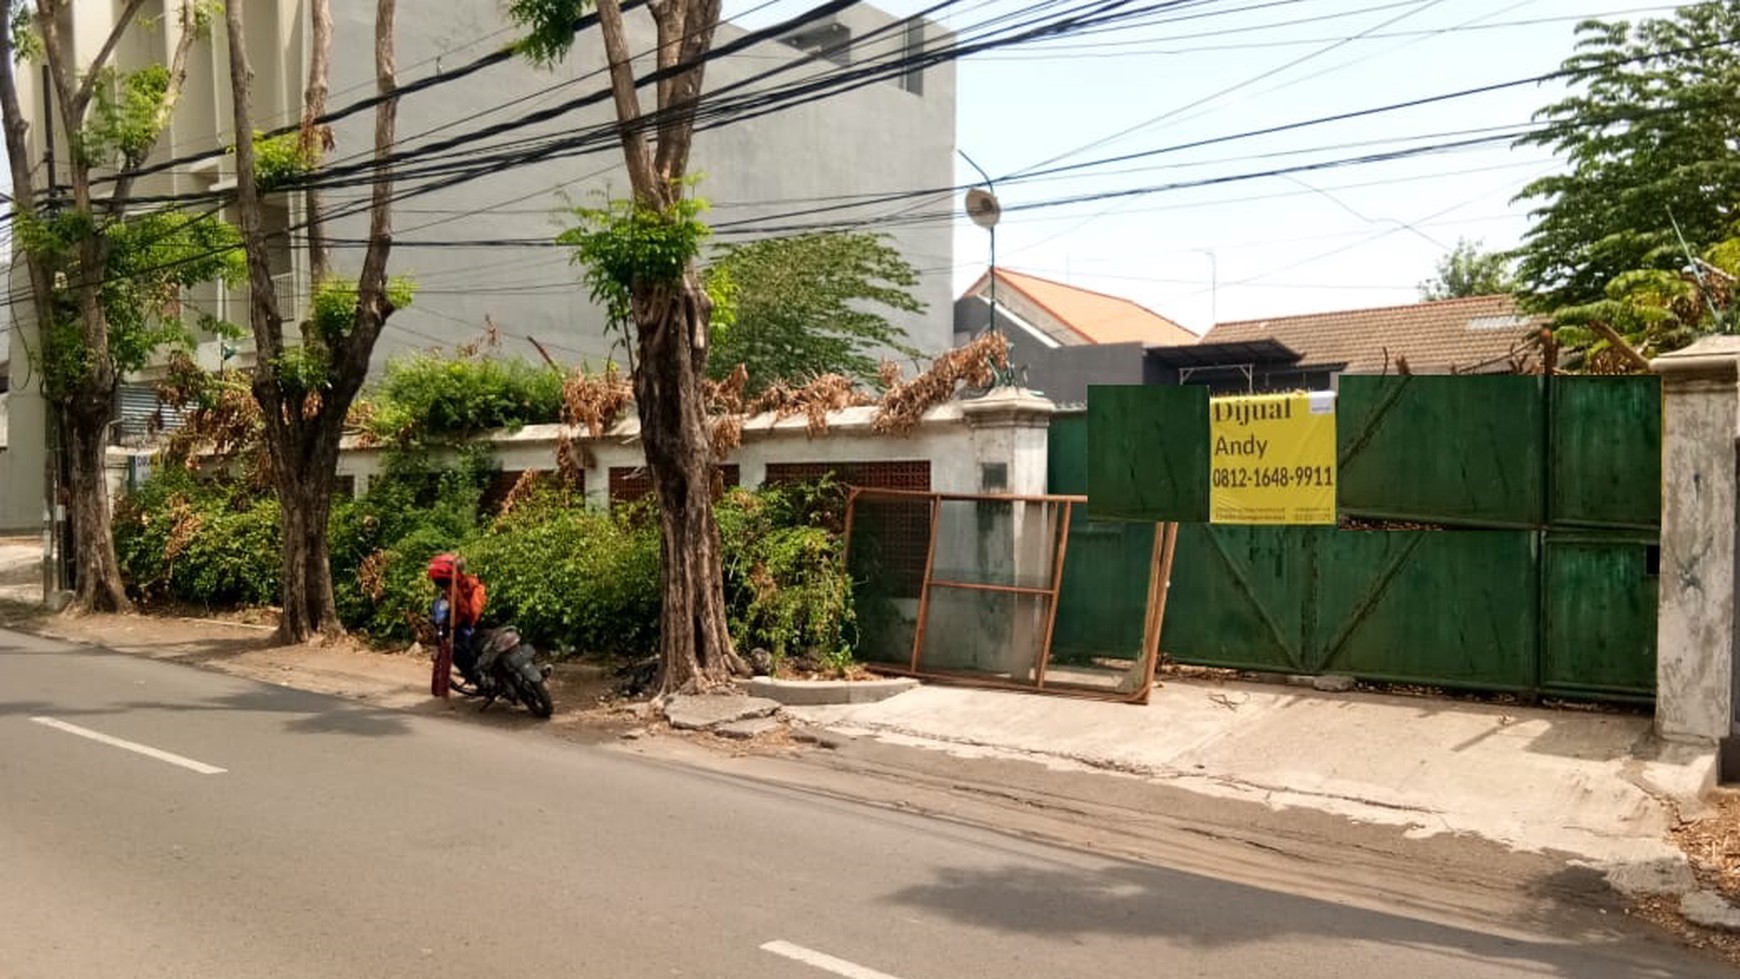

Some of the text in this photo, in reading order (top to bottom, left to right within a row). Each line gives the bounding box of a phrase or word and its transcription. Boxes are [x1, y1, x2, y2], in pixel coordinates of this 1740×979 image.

[1215, 398, 1291, 425] Dijual
[1215, 434, 1268, 460] Andy
[1213, 466, 1333, 488] 0812-1648-9911
